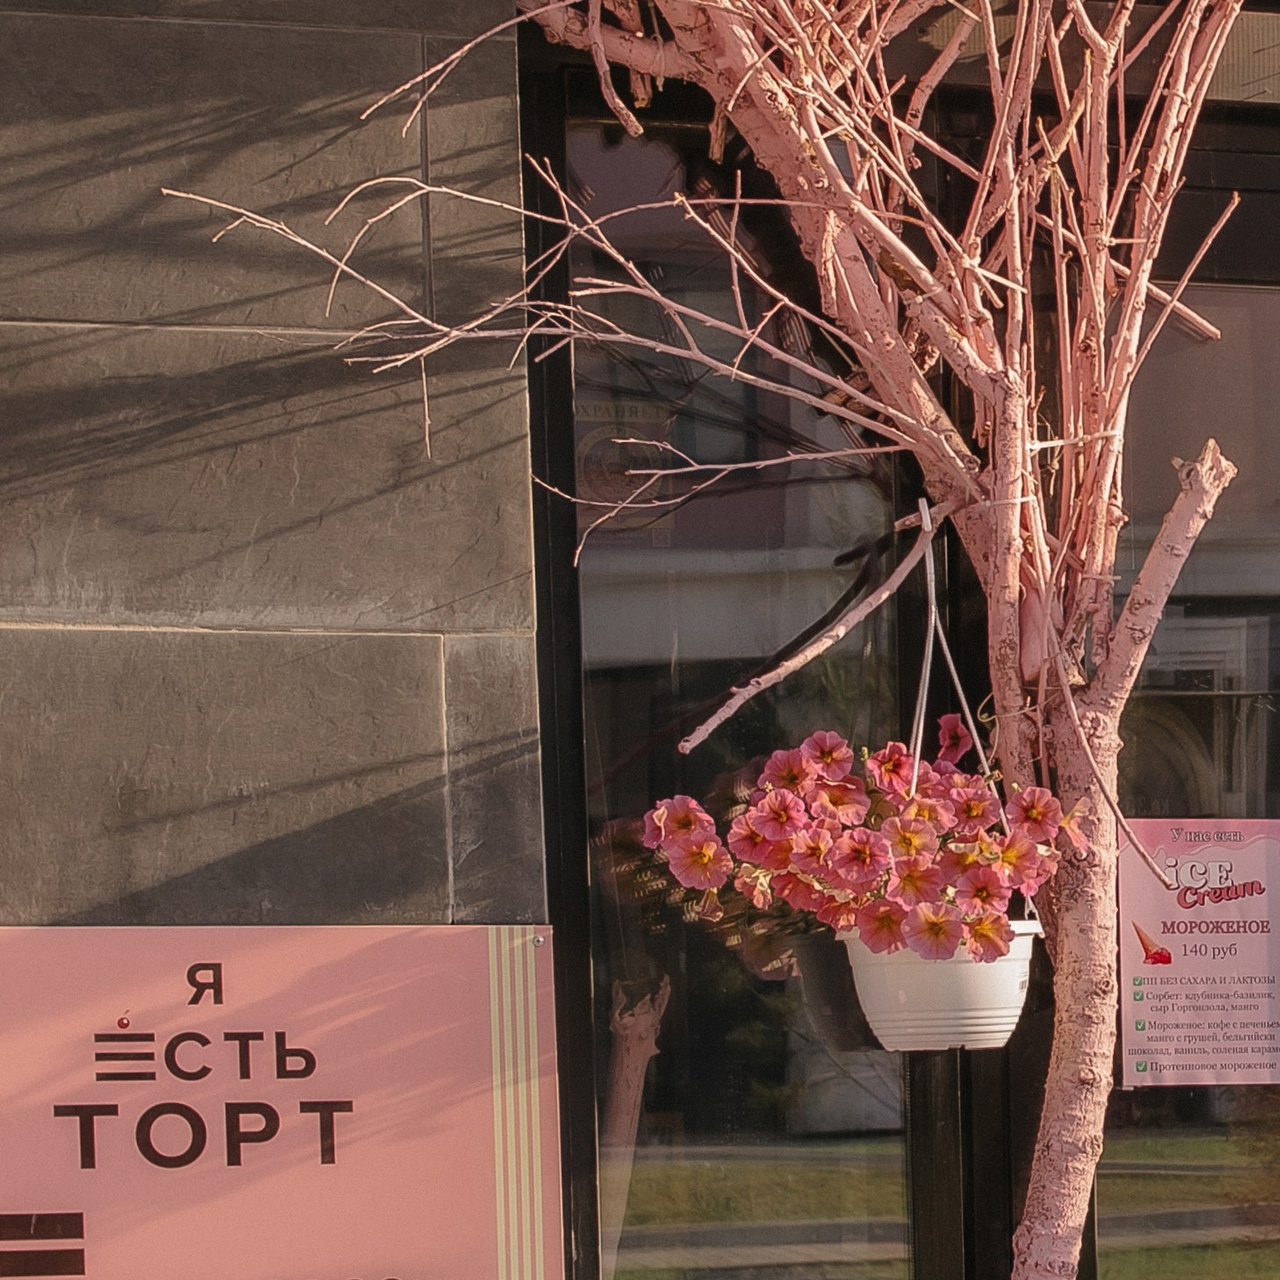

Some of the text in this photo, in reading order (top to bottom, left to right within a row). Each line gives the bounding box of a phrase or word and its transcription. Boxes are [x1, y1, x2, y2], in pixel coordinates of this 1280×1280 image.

[1170, 828, 1244, 842] У нас есть
[1177, 880, 1265, 909] Cream
[1161, 920, 1271, 934] МОРОЖЕНОЕ
[1182, 943, 1237, 959] 140 руб
[186, 962, 223, 1005] Я
[1142, 976, 1276, 985] ПП БЕЗ САХАРА И ЛАКТОЗЫ
[1146, 990, 1275, 1002] Сорбет: клубника-базилик,
[1150, 1003, 1168, 1014] сыр
[1231, 1003, 1259, 1012] манго
[1148, 1020, 1205, 1032] Мороженое:
[1207, 1019, 1231, 1031] кофе
[1233, 1021, 1239, 1029] с
[1146, 1034, 1175, 1043] манго
[1176, 1034, 1182, 1042] с
[1183, 1032, 1221, 1044] грушей,
[1128, 1047, 1172, 1057] шоколад,
[1174, 1046, 1209, 1056] ваниль,
[1212, 1046, 1249, 1055] соленая
[1150, 1061, 1276, 1073] Протеиновое мороженое
[53, 1100, 354, 1170] ТОРТ
